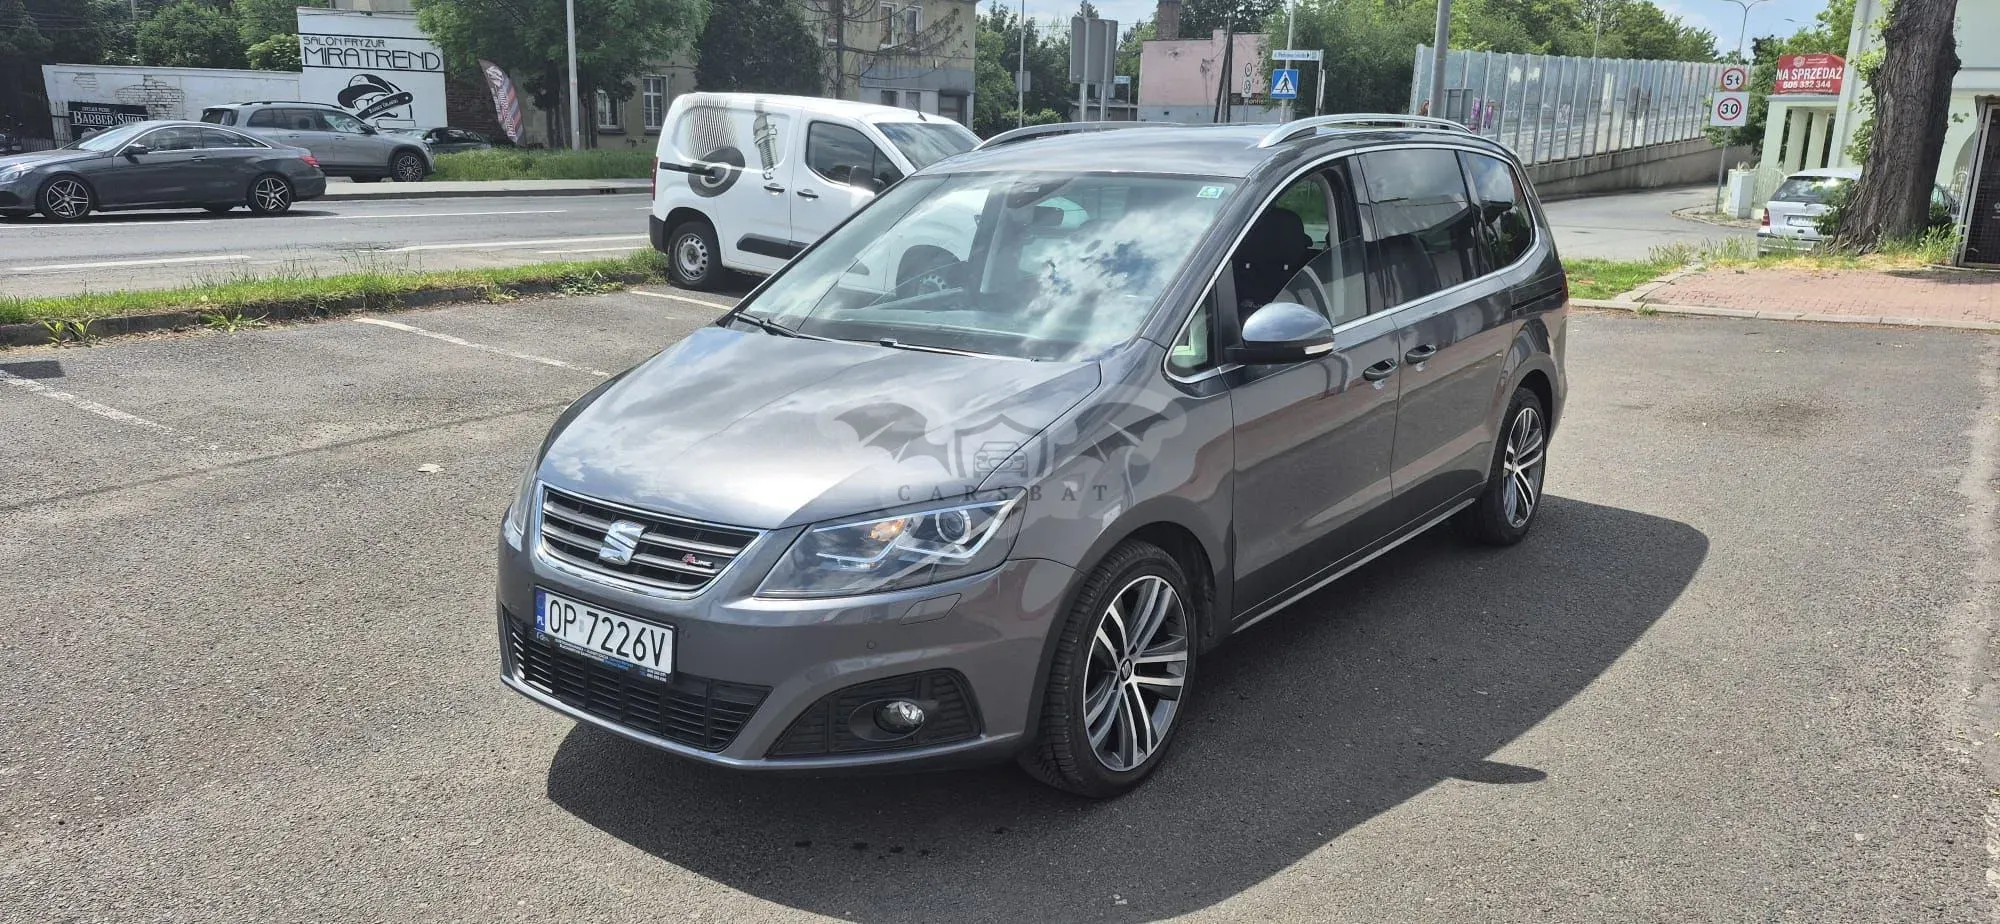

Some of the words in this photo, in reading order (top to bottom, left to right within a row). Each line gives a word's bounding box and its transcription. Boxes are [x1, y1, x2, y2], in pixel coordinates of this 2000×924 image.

[303, 36, 342, 46] SALON
[344, 38, 385, 48] FRYZUR
[303, 46, 441, 70] MIRATREND
[1776, 68, 1789, 81] NA
[1791, 66, 1843, 80] SPRZEDAŻ
[1720, 103, 1739, 115] 30
[73, 111, 114, 125] BARBER
[549, 599, 577, 638] OP
[586, 610, 666, 667] 7226V
